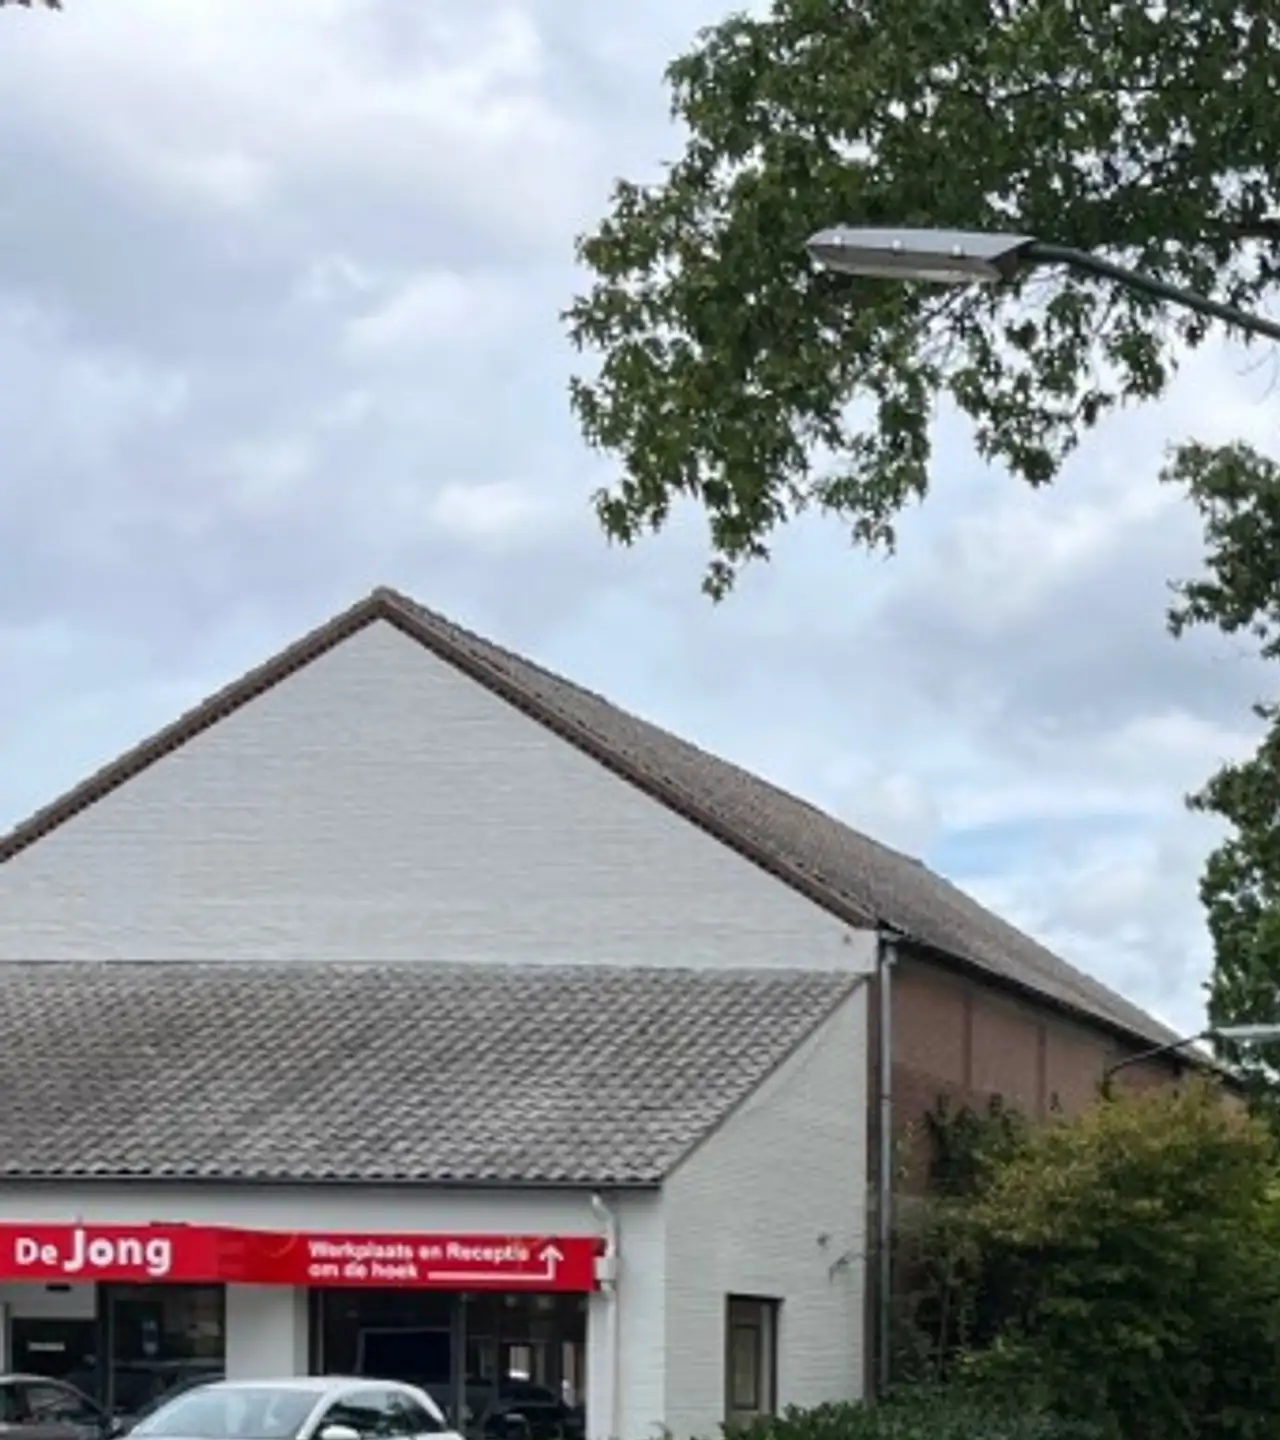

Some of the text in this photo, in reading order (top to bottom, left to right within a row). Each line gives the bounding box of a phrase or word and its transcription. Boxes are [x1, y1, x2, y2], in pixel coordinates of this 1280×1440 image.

[14, 1228, 172, 1276] De Jong
[308, 1241, 530, 1265] Werkplaats en Receptie
[308, 1261, 418, 1279] om de hoek
